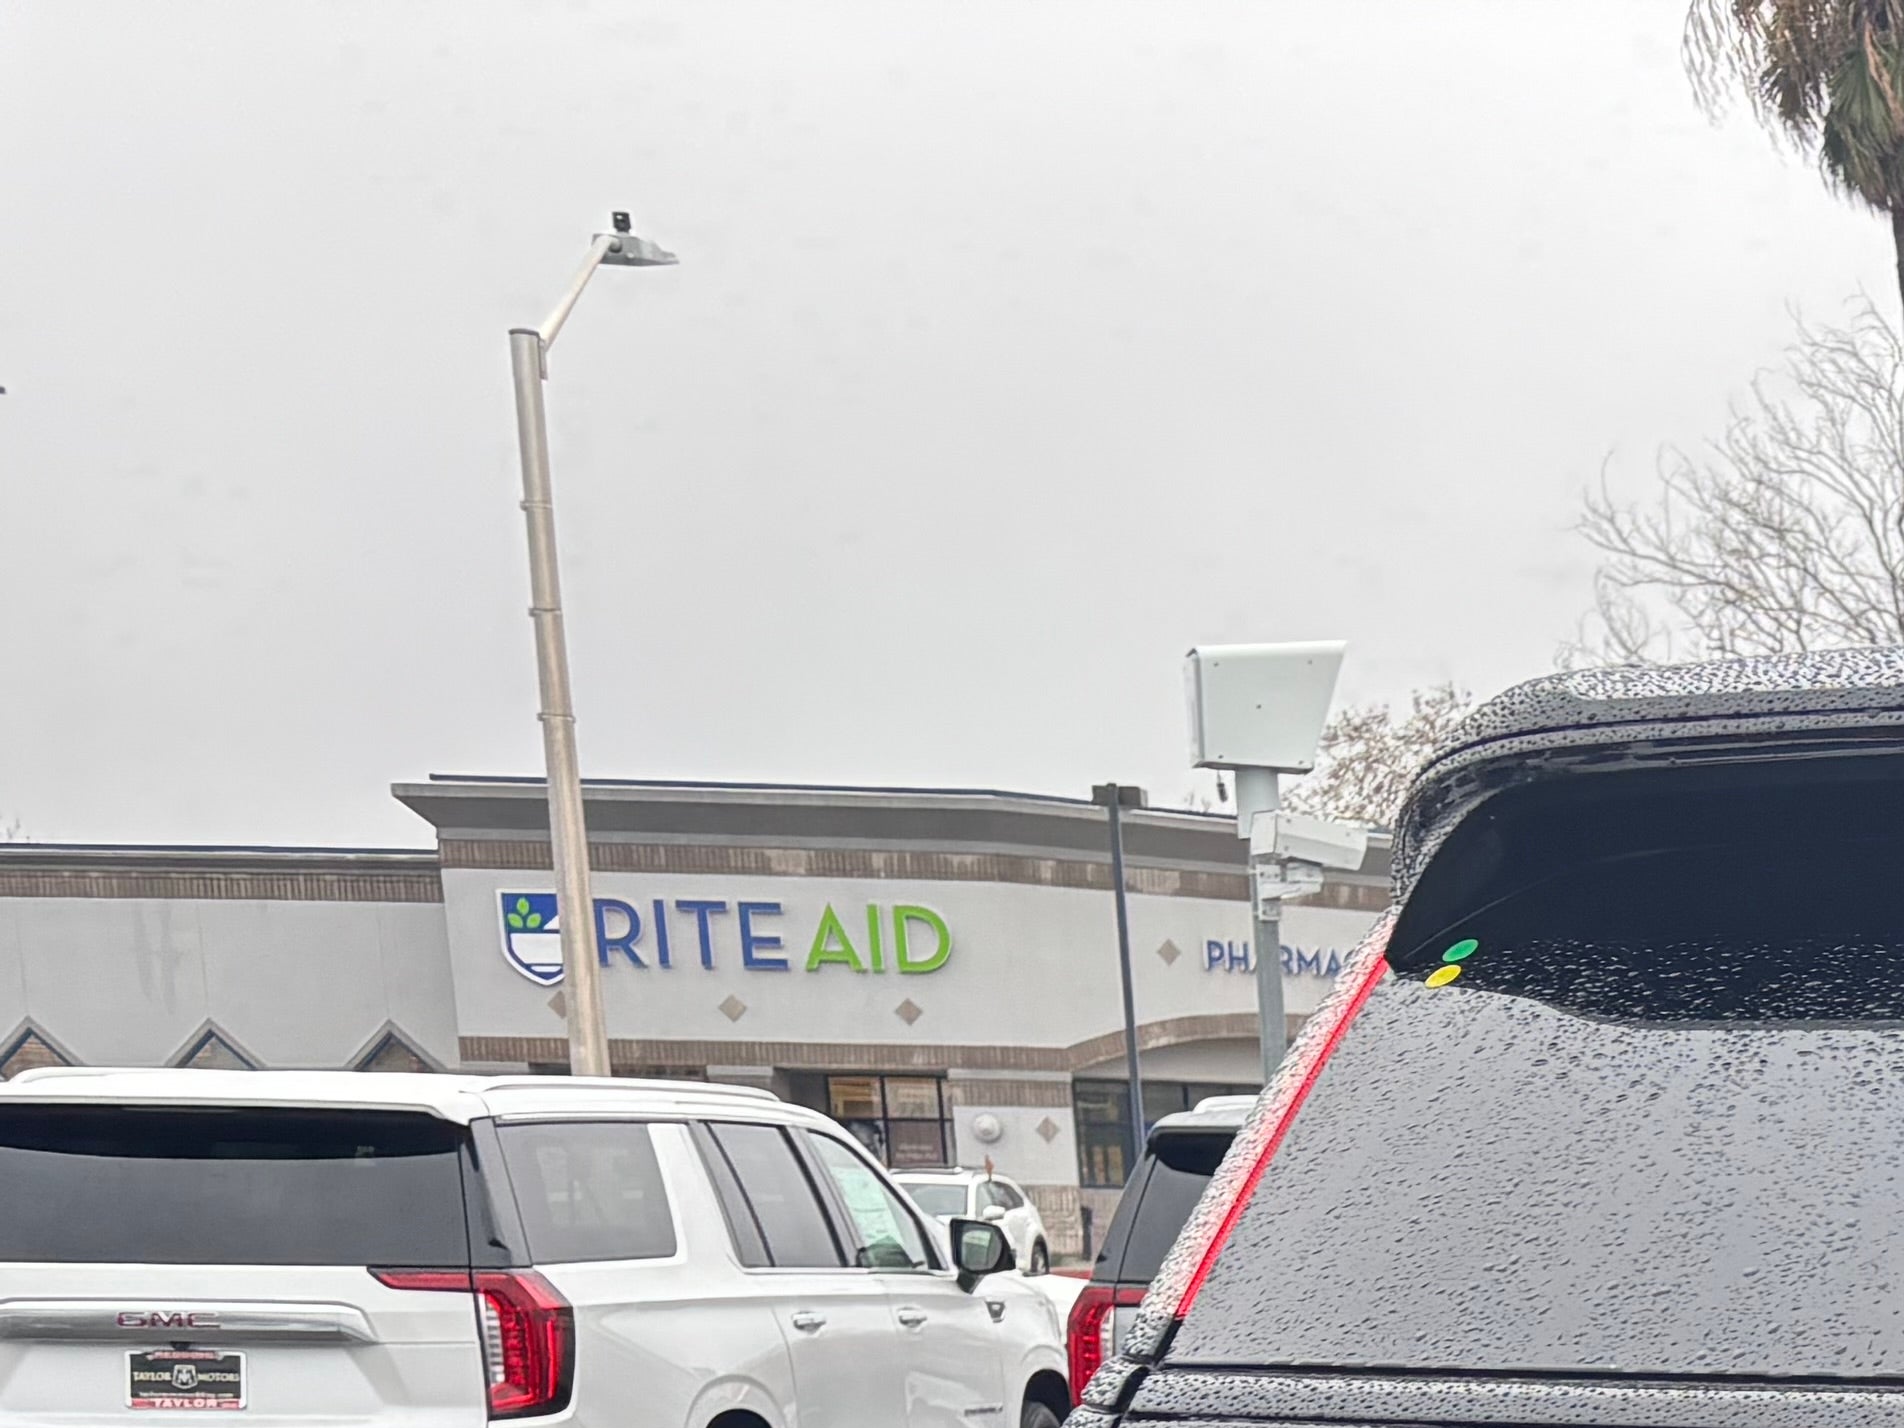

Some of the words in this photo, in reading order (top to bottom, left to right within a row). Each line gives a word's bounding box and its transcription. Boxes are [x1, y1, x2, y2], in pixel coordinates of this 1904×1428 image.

[592, 898, 790, 971] RITE
[805, 902, 953, 975] AID
[116, 1311, 221, 1329] GMC
